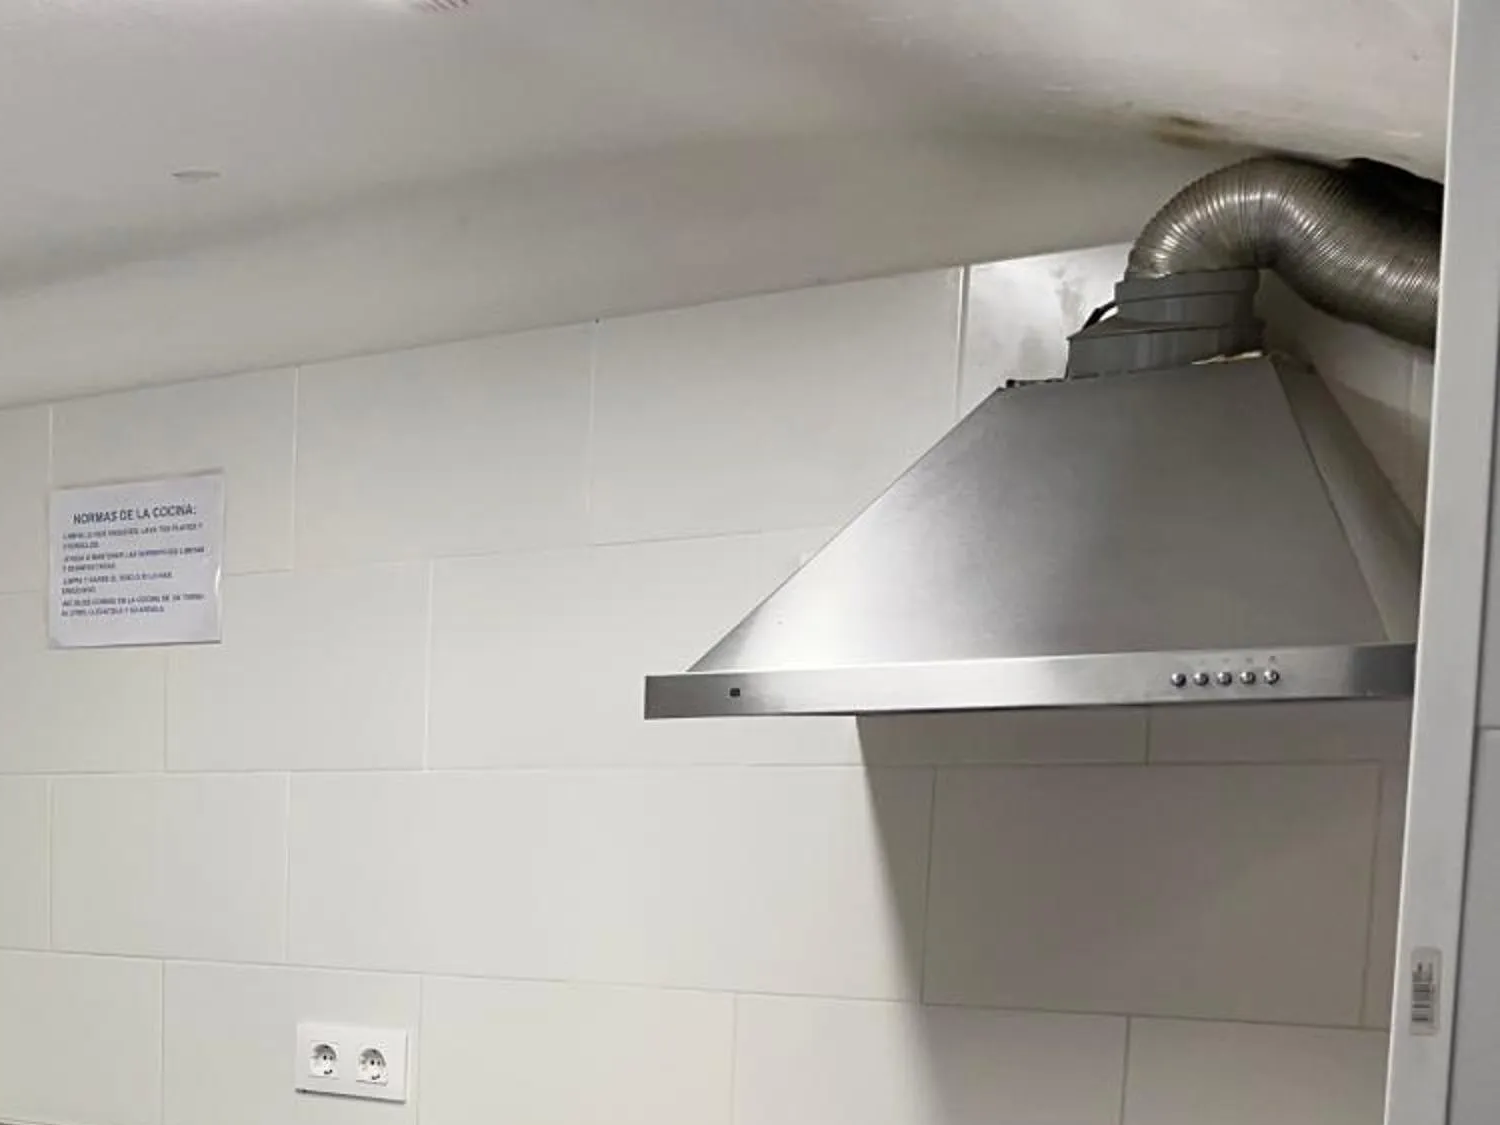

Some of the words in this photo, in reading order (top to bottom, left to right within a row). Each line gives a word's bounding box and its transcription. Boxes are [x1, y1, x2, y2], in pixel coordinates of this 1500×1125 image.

[73, 511, 117, 525] NORMAS
[119, 509, 133, 521] DE
[136, 508, 150, 520] LA
[152, 503, 197, 518] COCINA:
